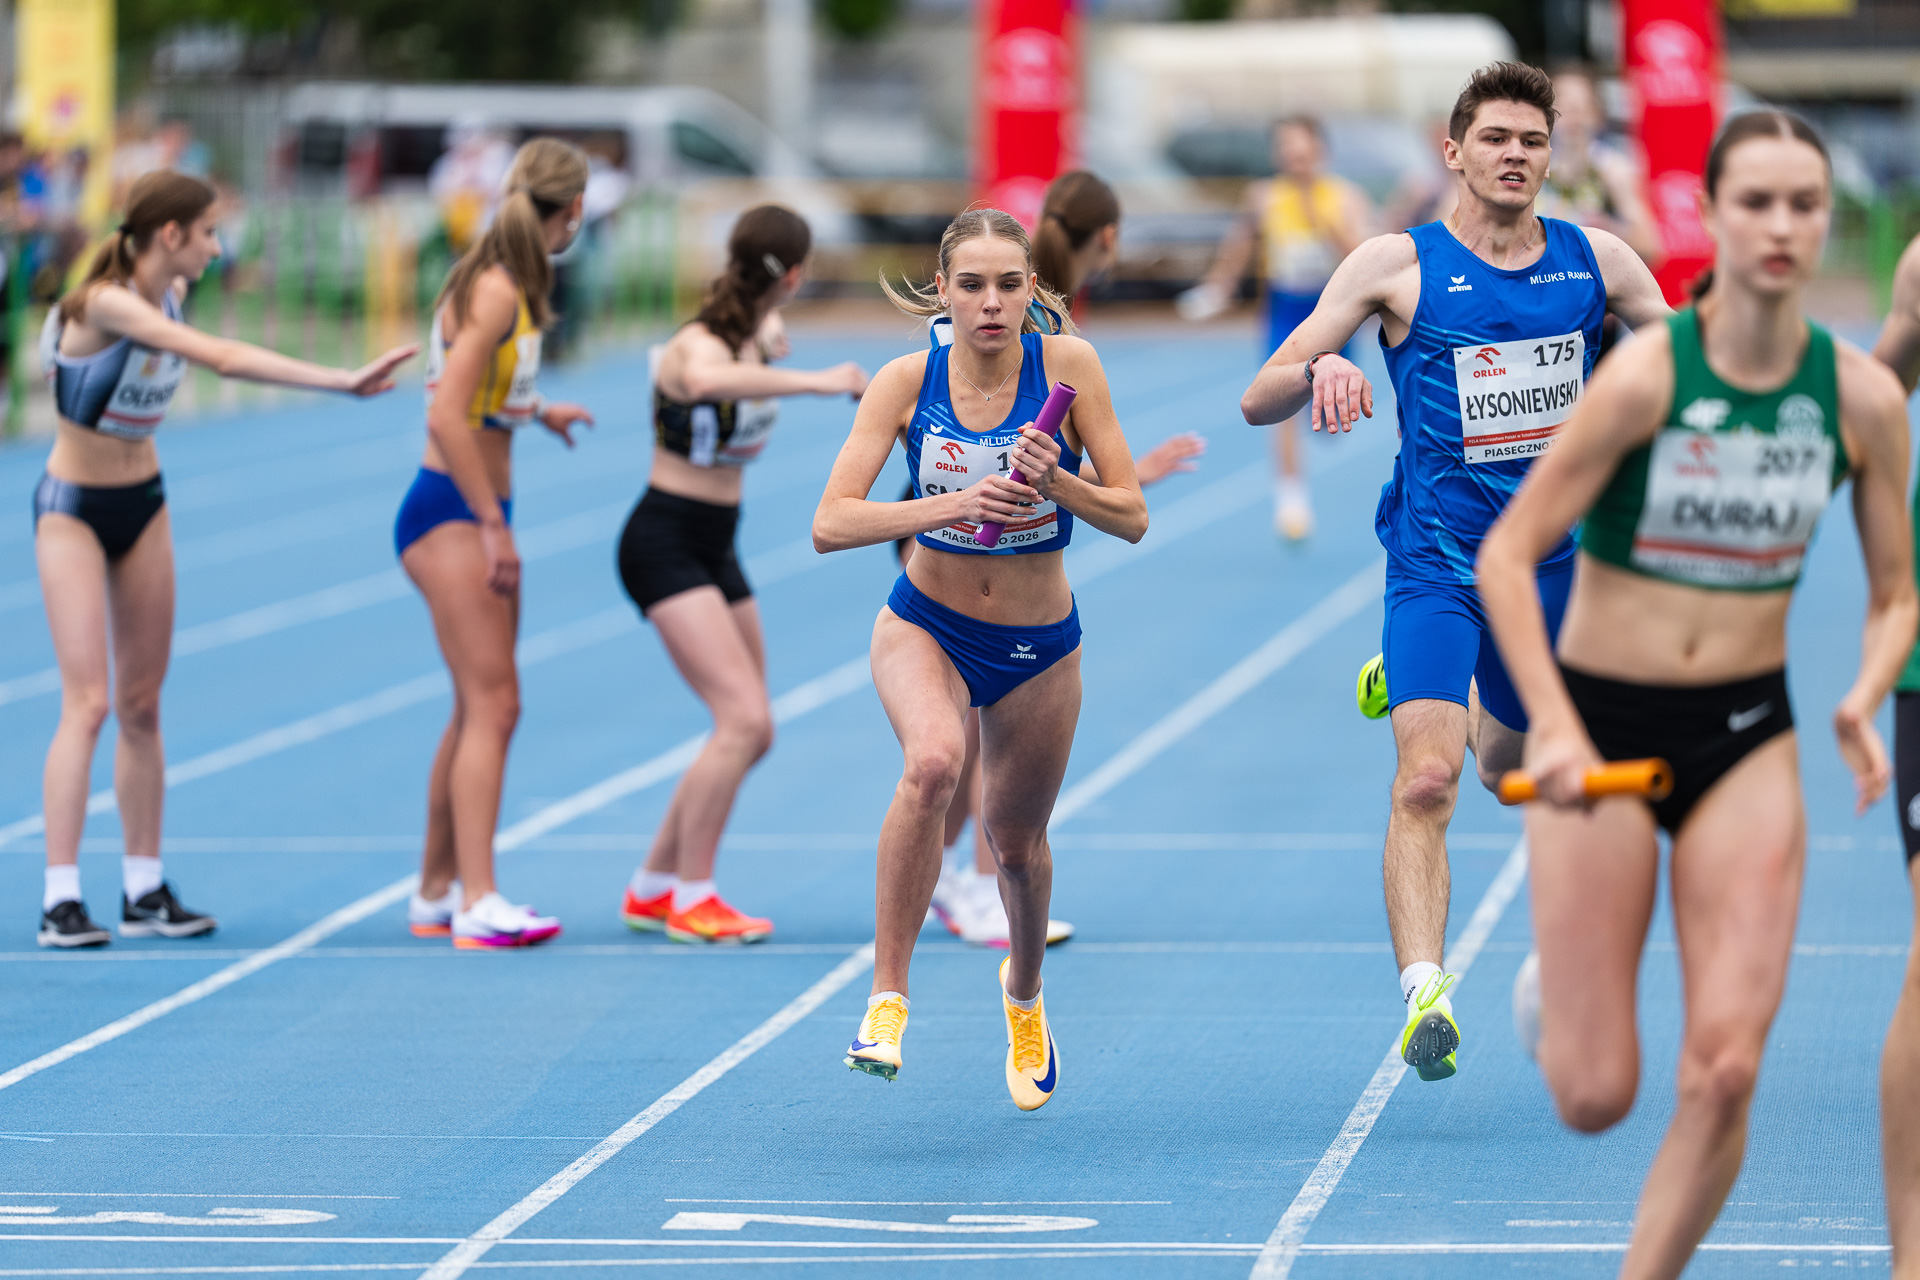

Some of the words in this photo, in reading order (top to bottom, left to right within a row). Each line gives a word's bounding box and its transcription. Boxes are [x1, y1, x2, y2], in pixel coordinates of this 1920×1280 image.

[1529, 272, 1566, 285] MLUKS
[1567, 270, 1594, 281] RAWA
[1447, 283, 1473, 293] erima
[1533, 339, 1576, 367] 175
[1473, 367, 1507, 379] ORLEN
[1465, 378, 1579, 421] ŁYSONIEWSKI
[979, 434, 1018, 447] MLUKS
[1484, 441, 1549, 458] PIASECZNO
[935, 461, 968, 474] ORLEN
[1756, 443, 1817, 477] 207
[1672, 495, 1800, 535] DURAJ
[942, 529, 1008, 546] PIASECO
[1009, 531, 1039, 544] 2026
[1010, 652, 1037, 660] erima
